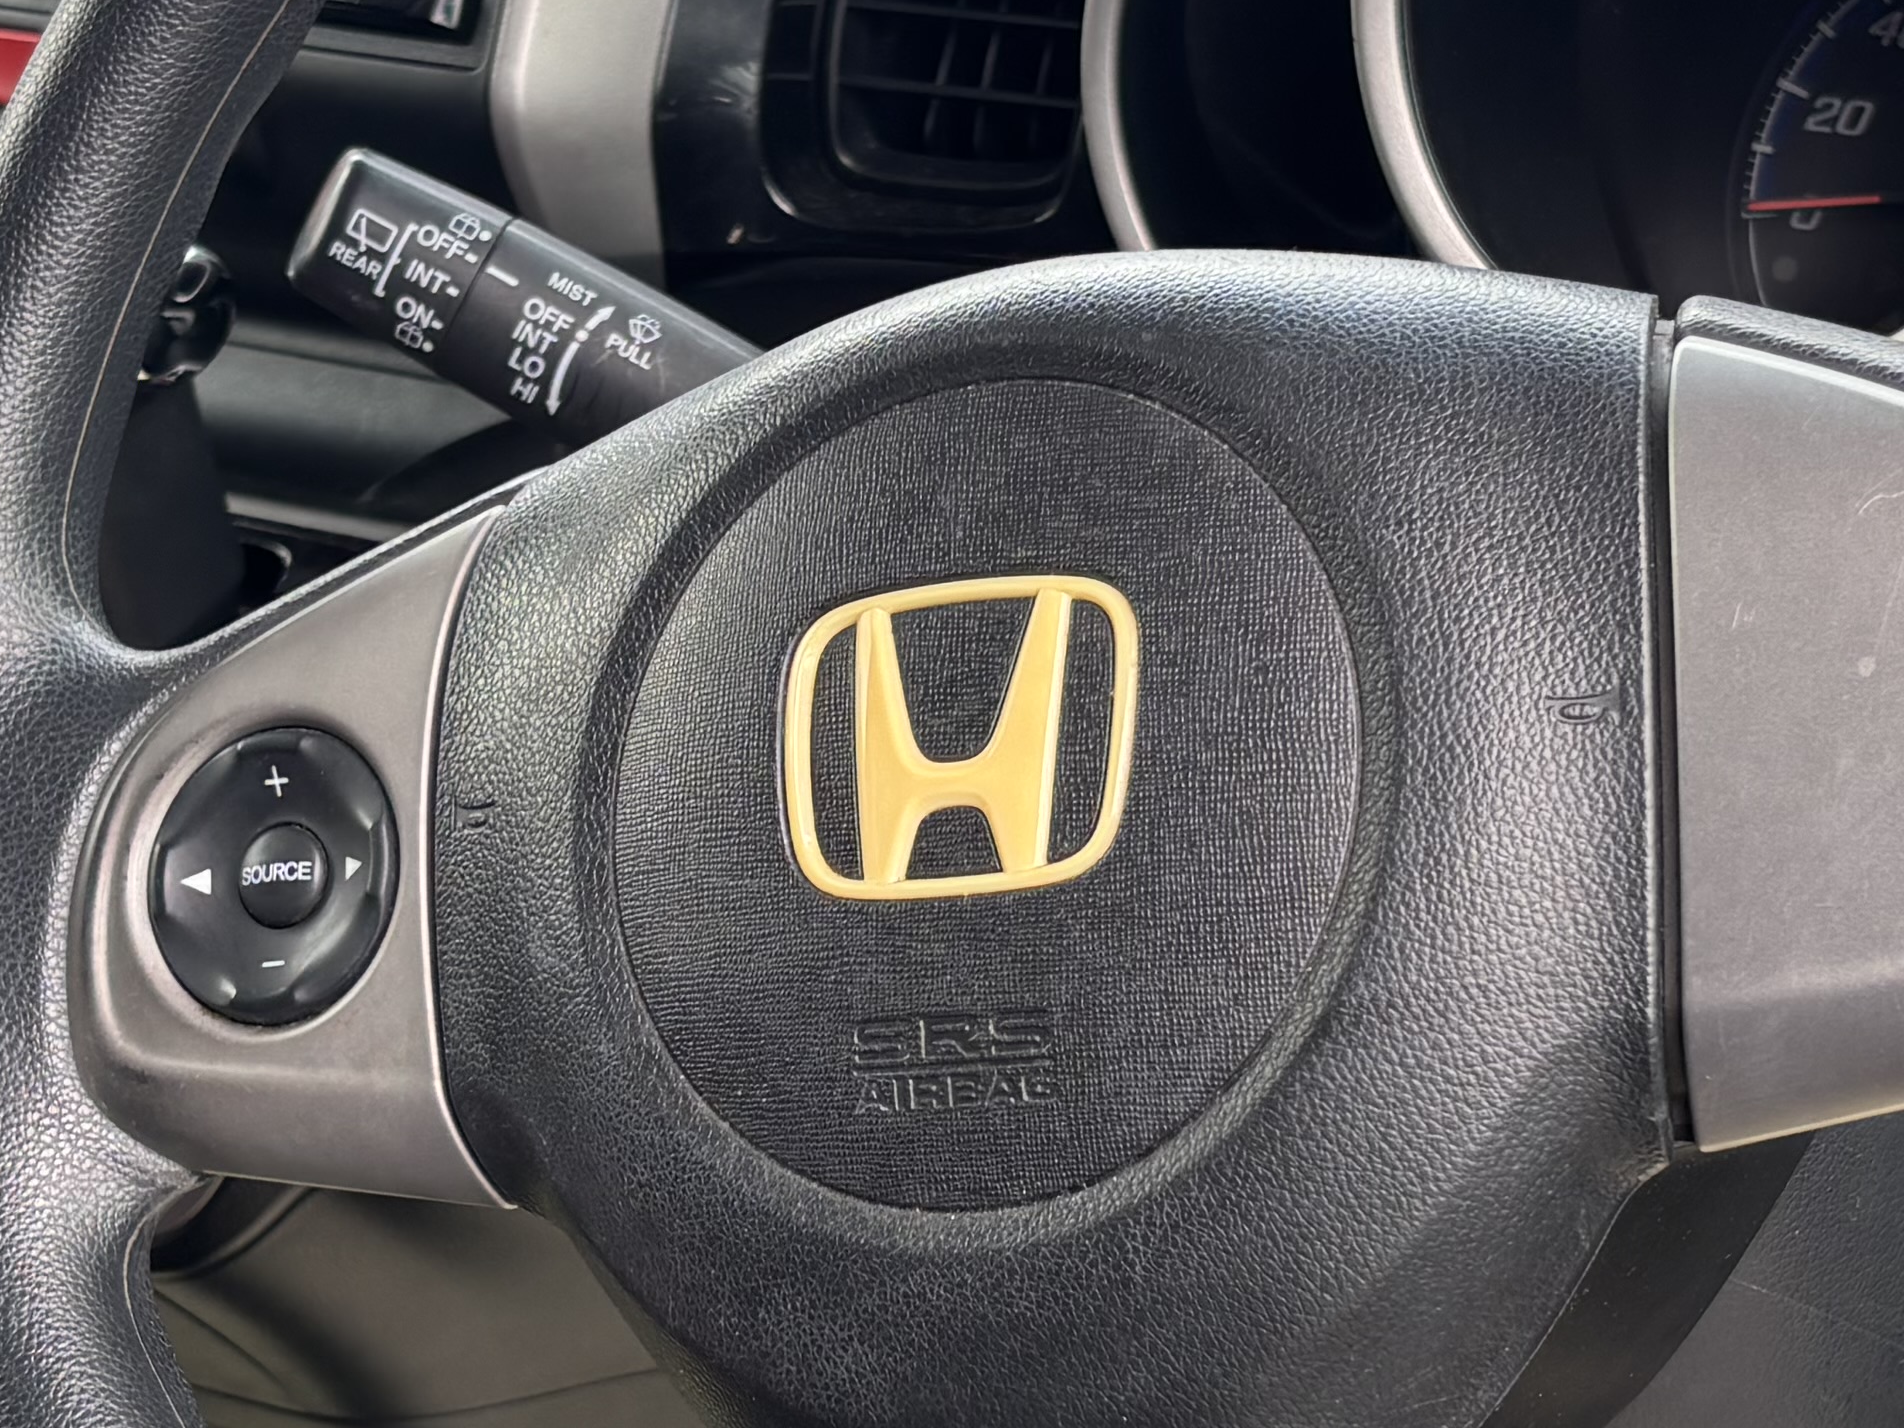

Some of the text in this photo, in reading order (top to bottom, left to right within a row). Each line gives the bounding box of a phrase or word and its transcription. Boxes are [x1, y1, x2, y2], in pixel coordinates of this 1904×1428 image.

[1804, 96, 1876, 136] 20
[417, 224, 469, 259] OFF
[328, 241, 383, 280] REAR
[405, 259, 451, 294] INT
[547, 272, 598, 306] MIST
[396, 296, 435, 329] ON
[523, 298, 575, 332] OFF
[511, 319, 559, 354] INT
[604, 333, 652, 370] PULL
[507, 346, 545, 378] LO
[510, 377, 540, 404] HI
[242, 861, 313, 886] SOURCE
[852, 1010, 1053, 1064] SRS
[854, 1074, 1062, 1115] AIRBAG
